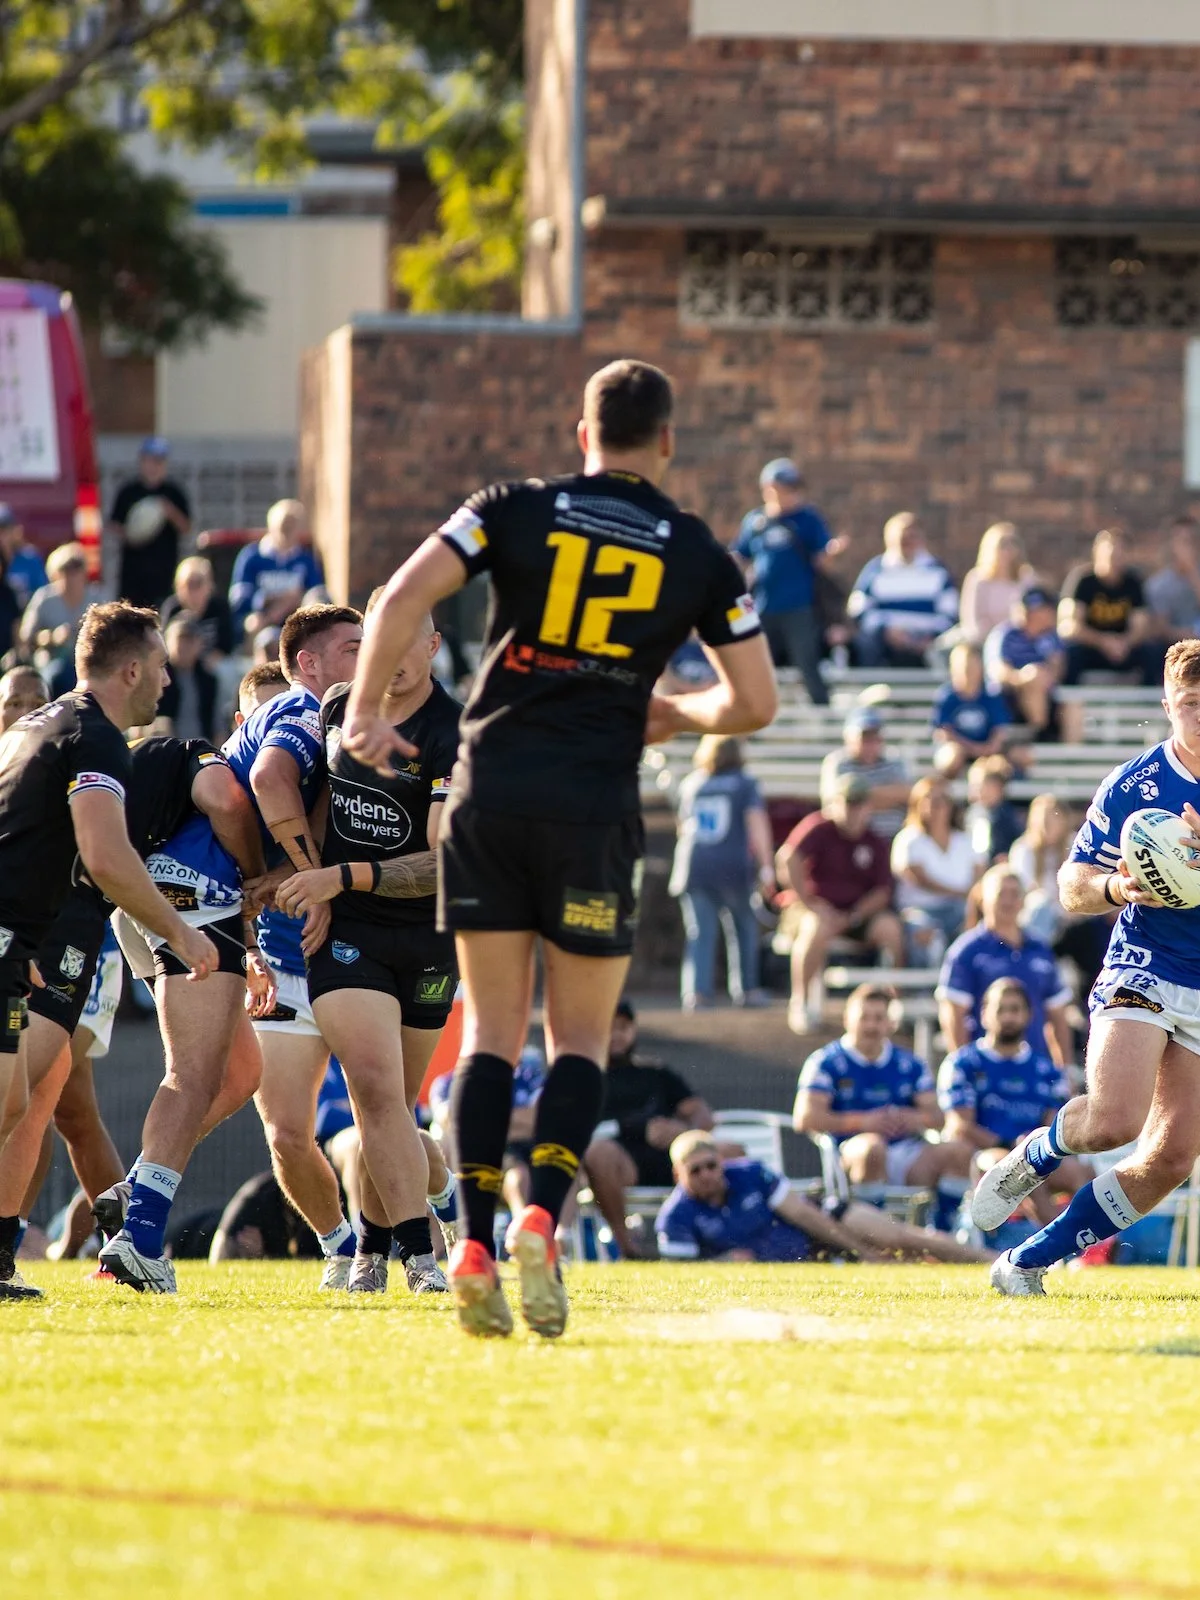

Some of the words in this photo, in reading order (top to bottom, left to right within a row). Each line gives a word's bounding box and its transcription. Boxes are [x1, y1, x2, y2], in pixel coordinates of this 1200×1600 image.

[540, 531, 664, 657] 12
[1120, 761, 1161, 794] DEICORP
[330, 790, 400, 822] ydens
[350, 814, 401, 838] lawyers
[146, 862, 200, 882] ENSON
[1134, 848, 1188, 908] STEEDEN
[166, 896, 195, 908] ECT
[152, 1171, 177, 1190] DEIC
[1104, 1190, 1134, 1225] DEIC
